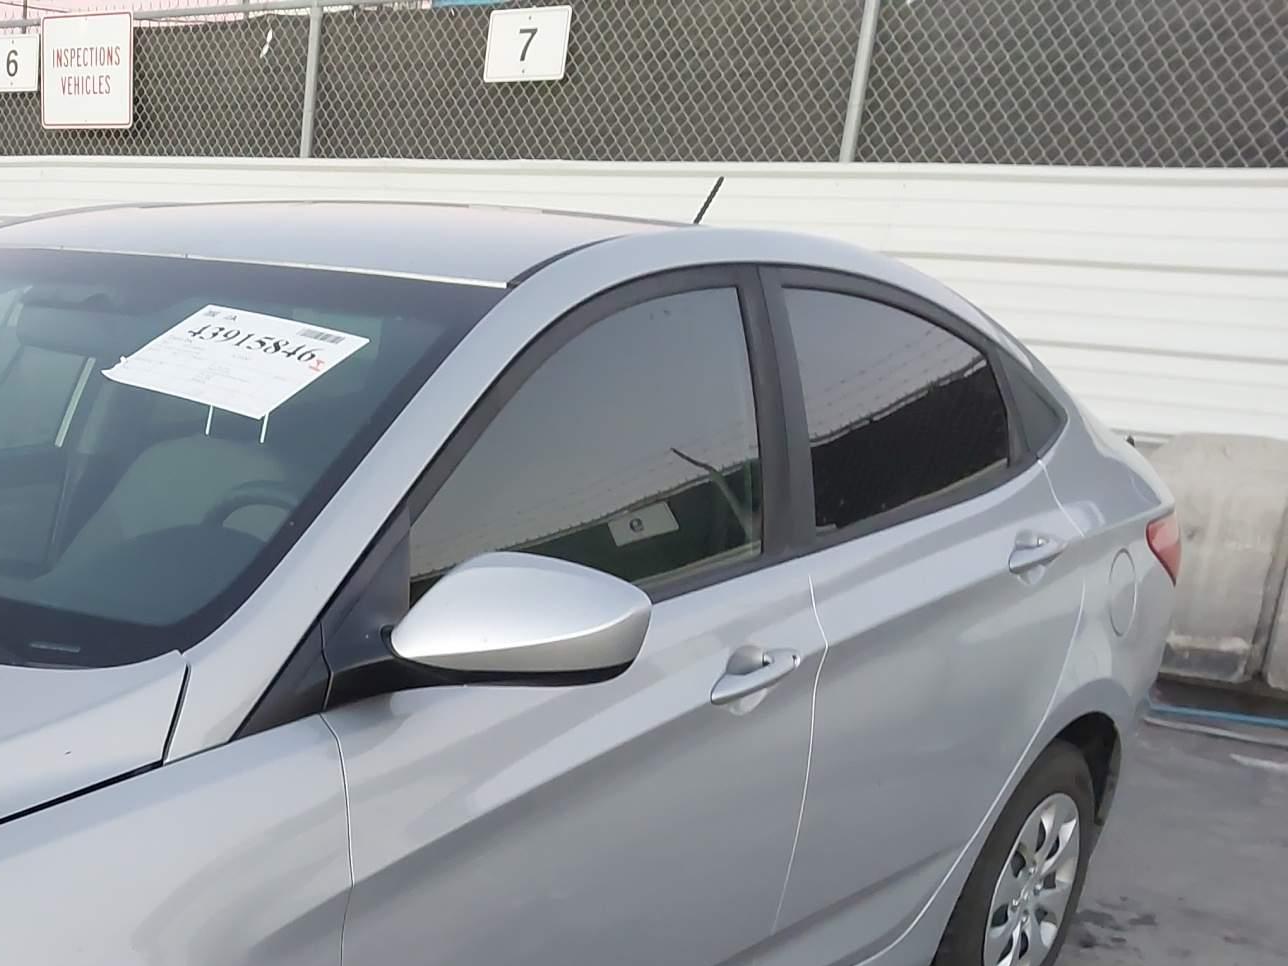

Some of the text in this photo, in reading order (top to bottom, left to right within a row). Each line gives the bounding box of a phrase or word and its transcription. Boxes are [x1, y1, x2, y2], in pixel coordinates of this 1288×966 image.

[52, 45, 121, 68] INSPECTIONS
[519, 27, 538, 62] 7
[5, 49, 19, 77] 6
[60, 74, 112, 95] VEHICLES
[187, 324, 319, 362] 43915846
